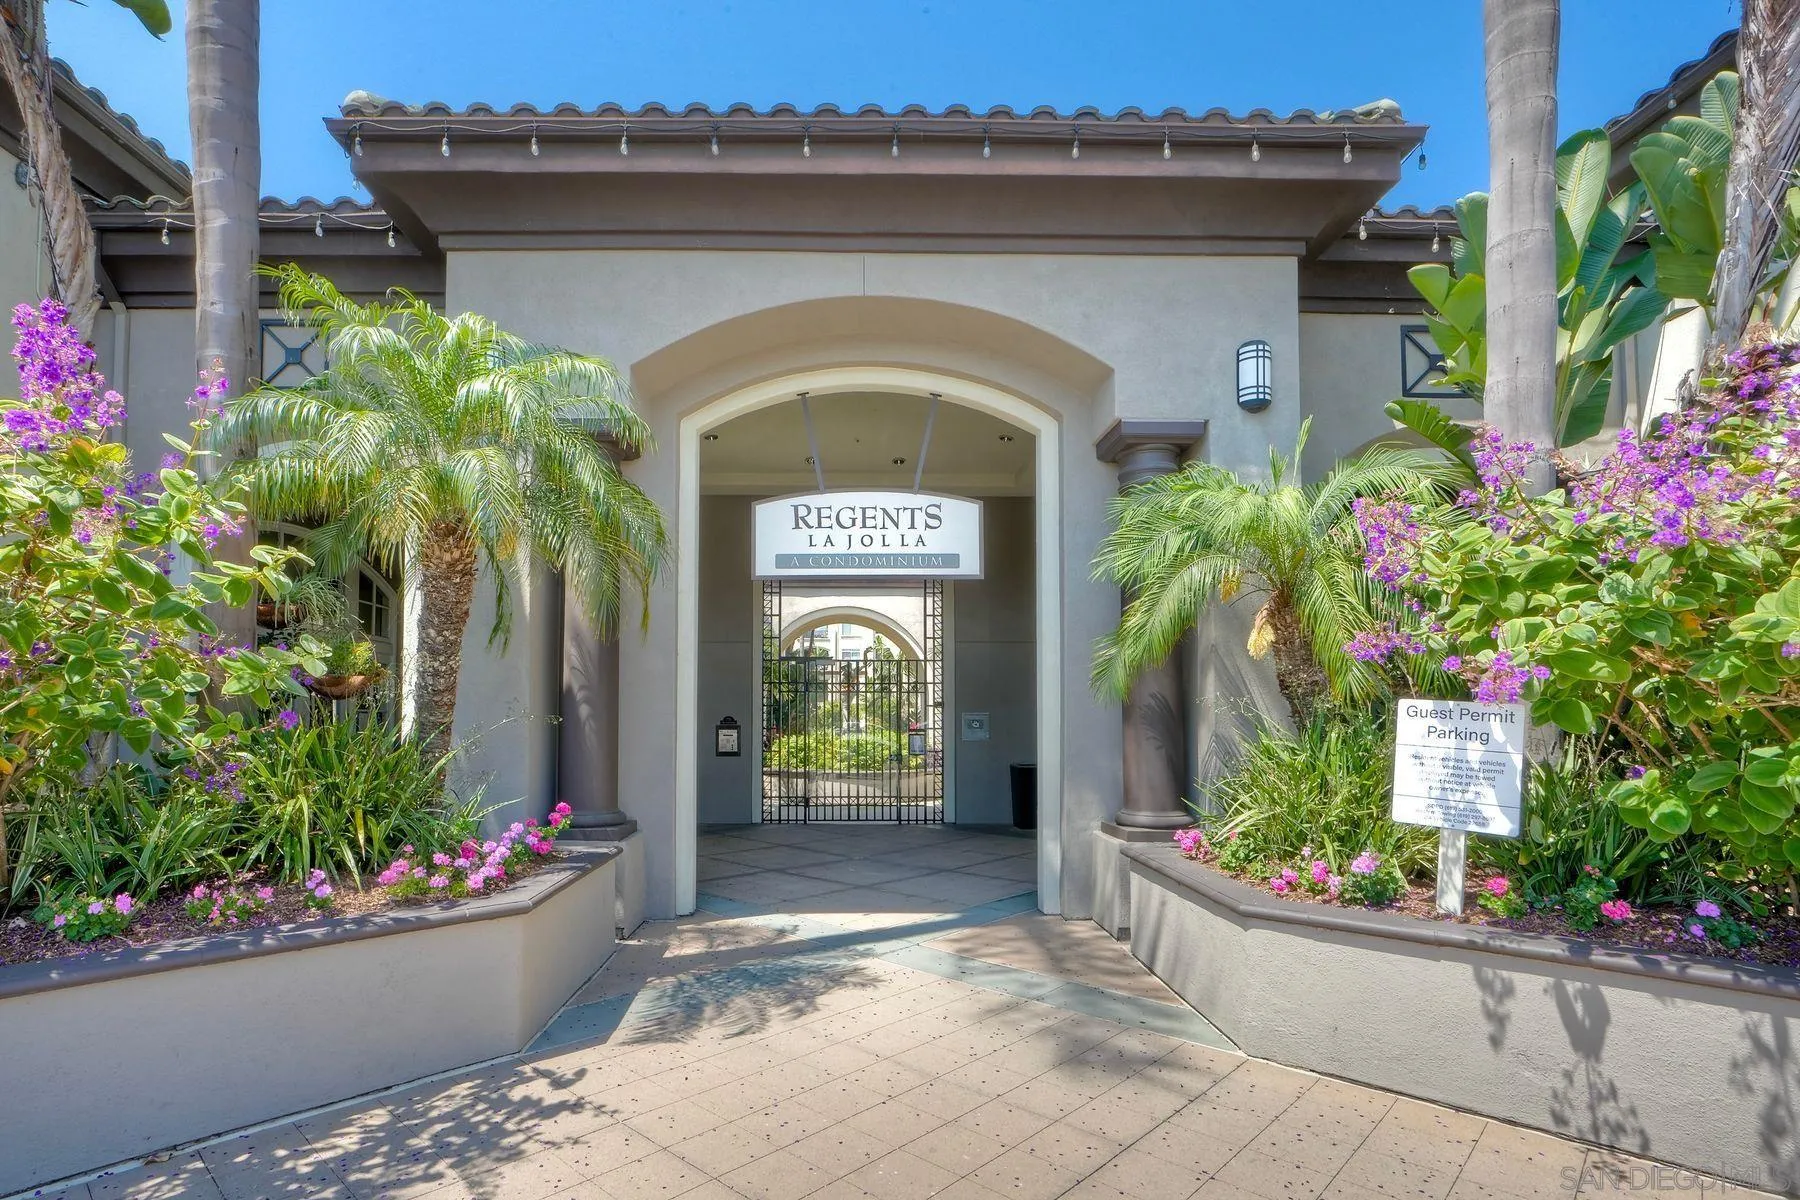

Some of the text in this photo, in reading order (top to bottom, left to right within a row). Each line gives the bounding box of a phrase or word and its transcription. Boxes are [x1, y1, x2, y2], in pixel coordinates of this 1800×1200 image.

[790, 502, 942, 531] REGENTS
[808, 534, 927, 551] LA JOLLA
[790, 554, 943, 567] A CONDOMINIUM
[1406, 705, 1516, 724] Guest Permit
[1427, 725, 1490, 745] Parking
[1479, 759, 1506, 768] vehicles
[1450, 772, 1465, 780] may
